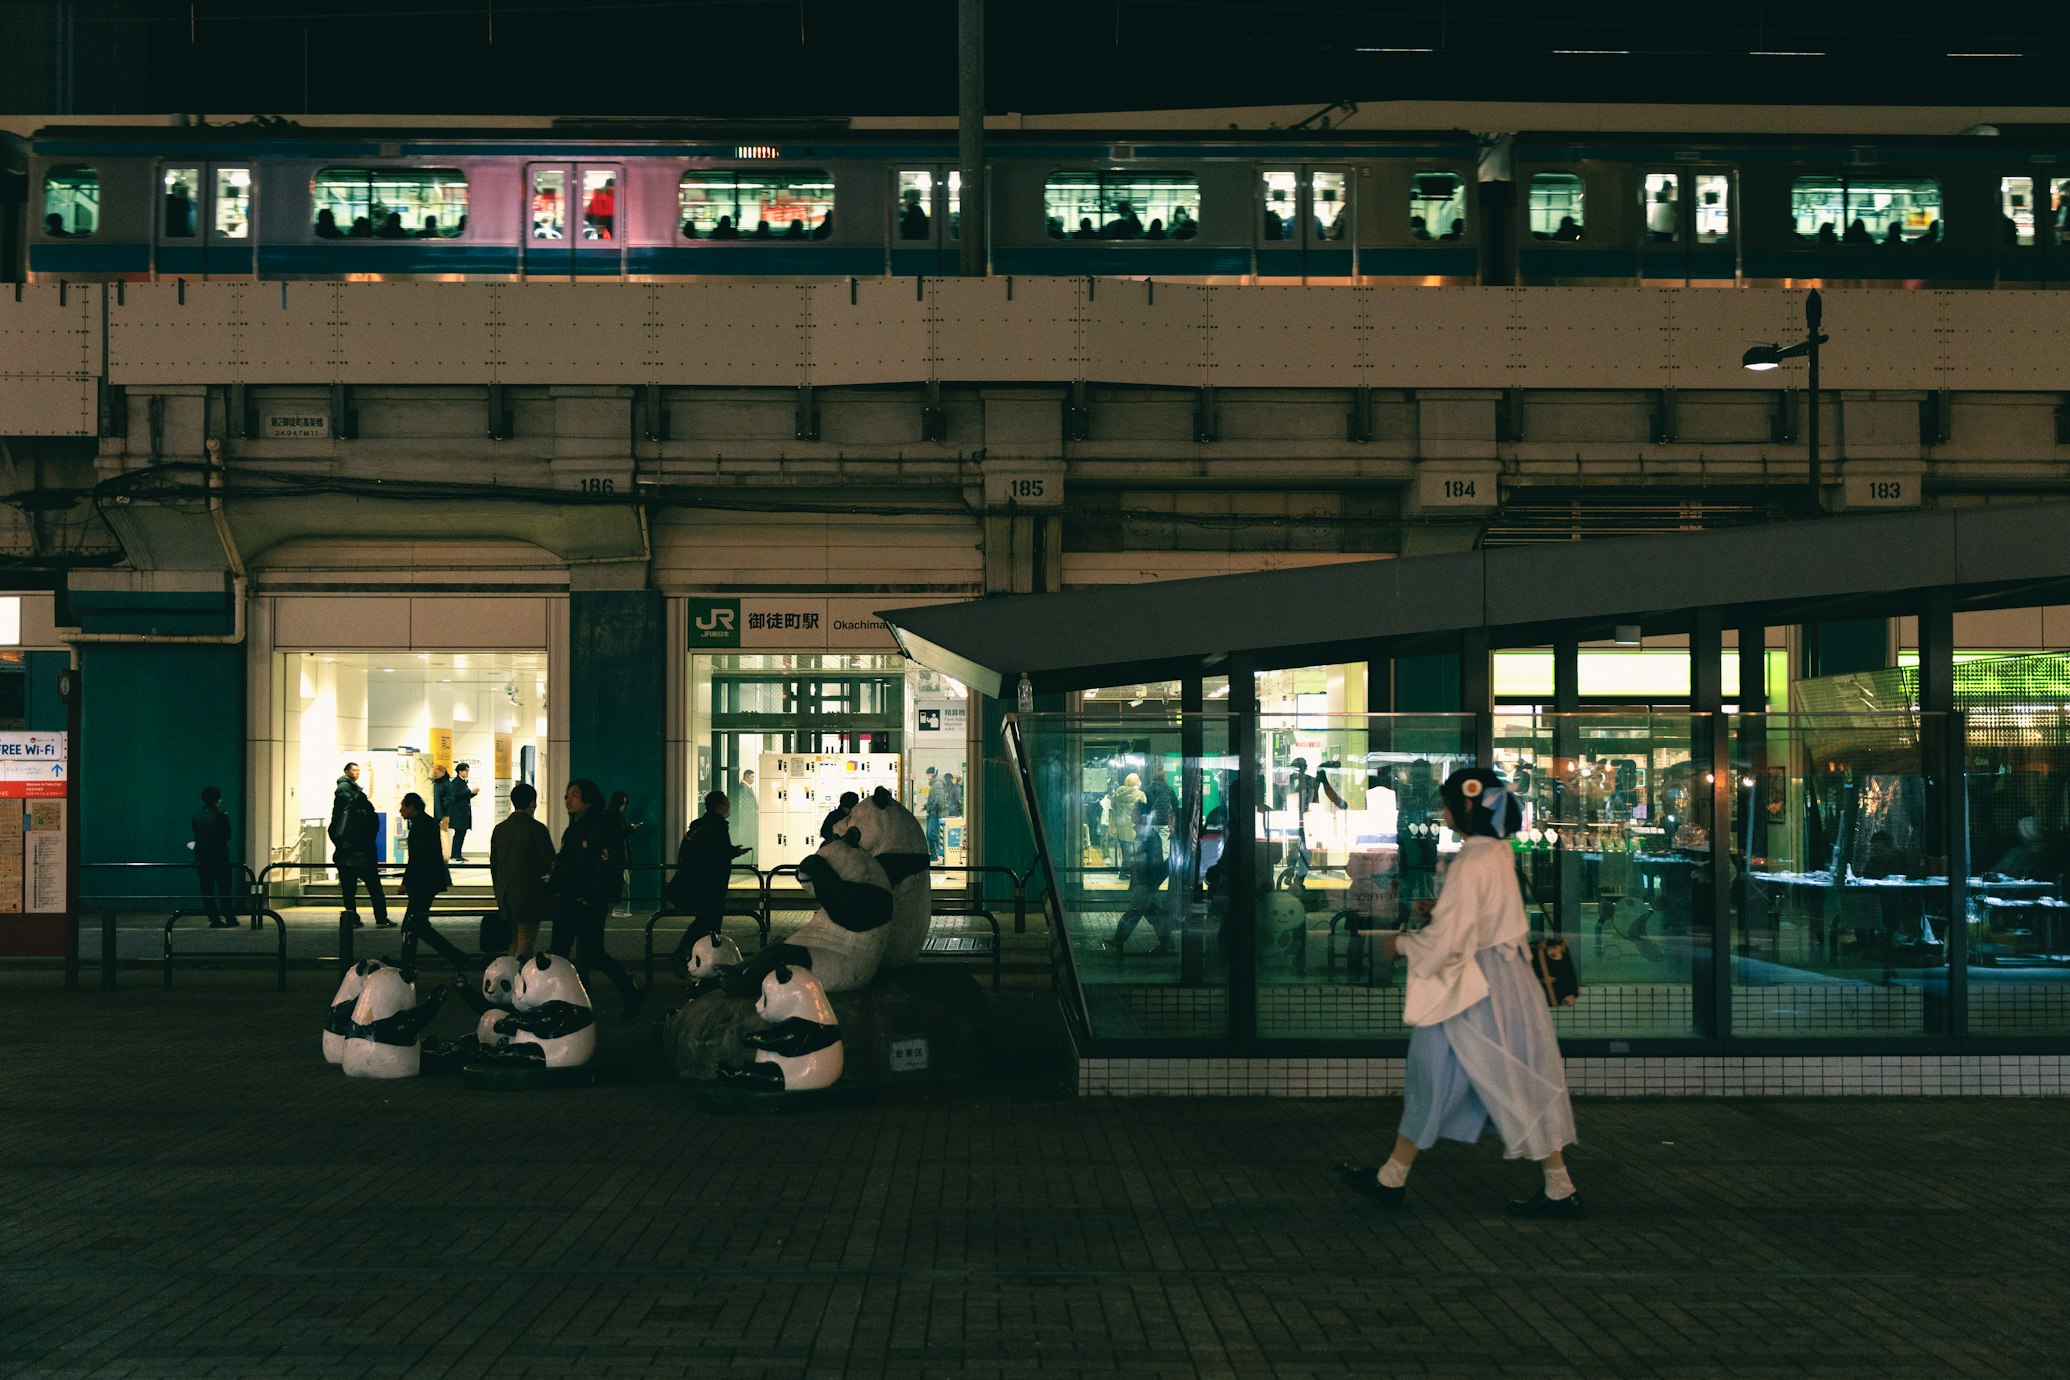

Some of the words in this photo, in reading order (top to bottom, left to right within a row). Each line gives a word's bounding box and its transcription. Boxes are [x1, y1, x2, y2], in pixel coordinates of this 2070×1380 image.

[581, 478, 614, 496] 186
[1011, 480, 1044, 497] 185
[1444, 480, 1475, 497] 184
[1870, 482, 1900, 499] 183
[696, 608, 735, 630] JR
[748, 613, 819, 630] 御徒町駅
[701, 630, 730, 638] JR東日本
[0, 744, 21, 755] REE
[25, 744, 54, 755] Wi-Fi
